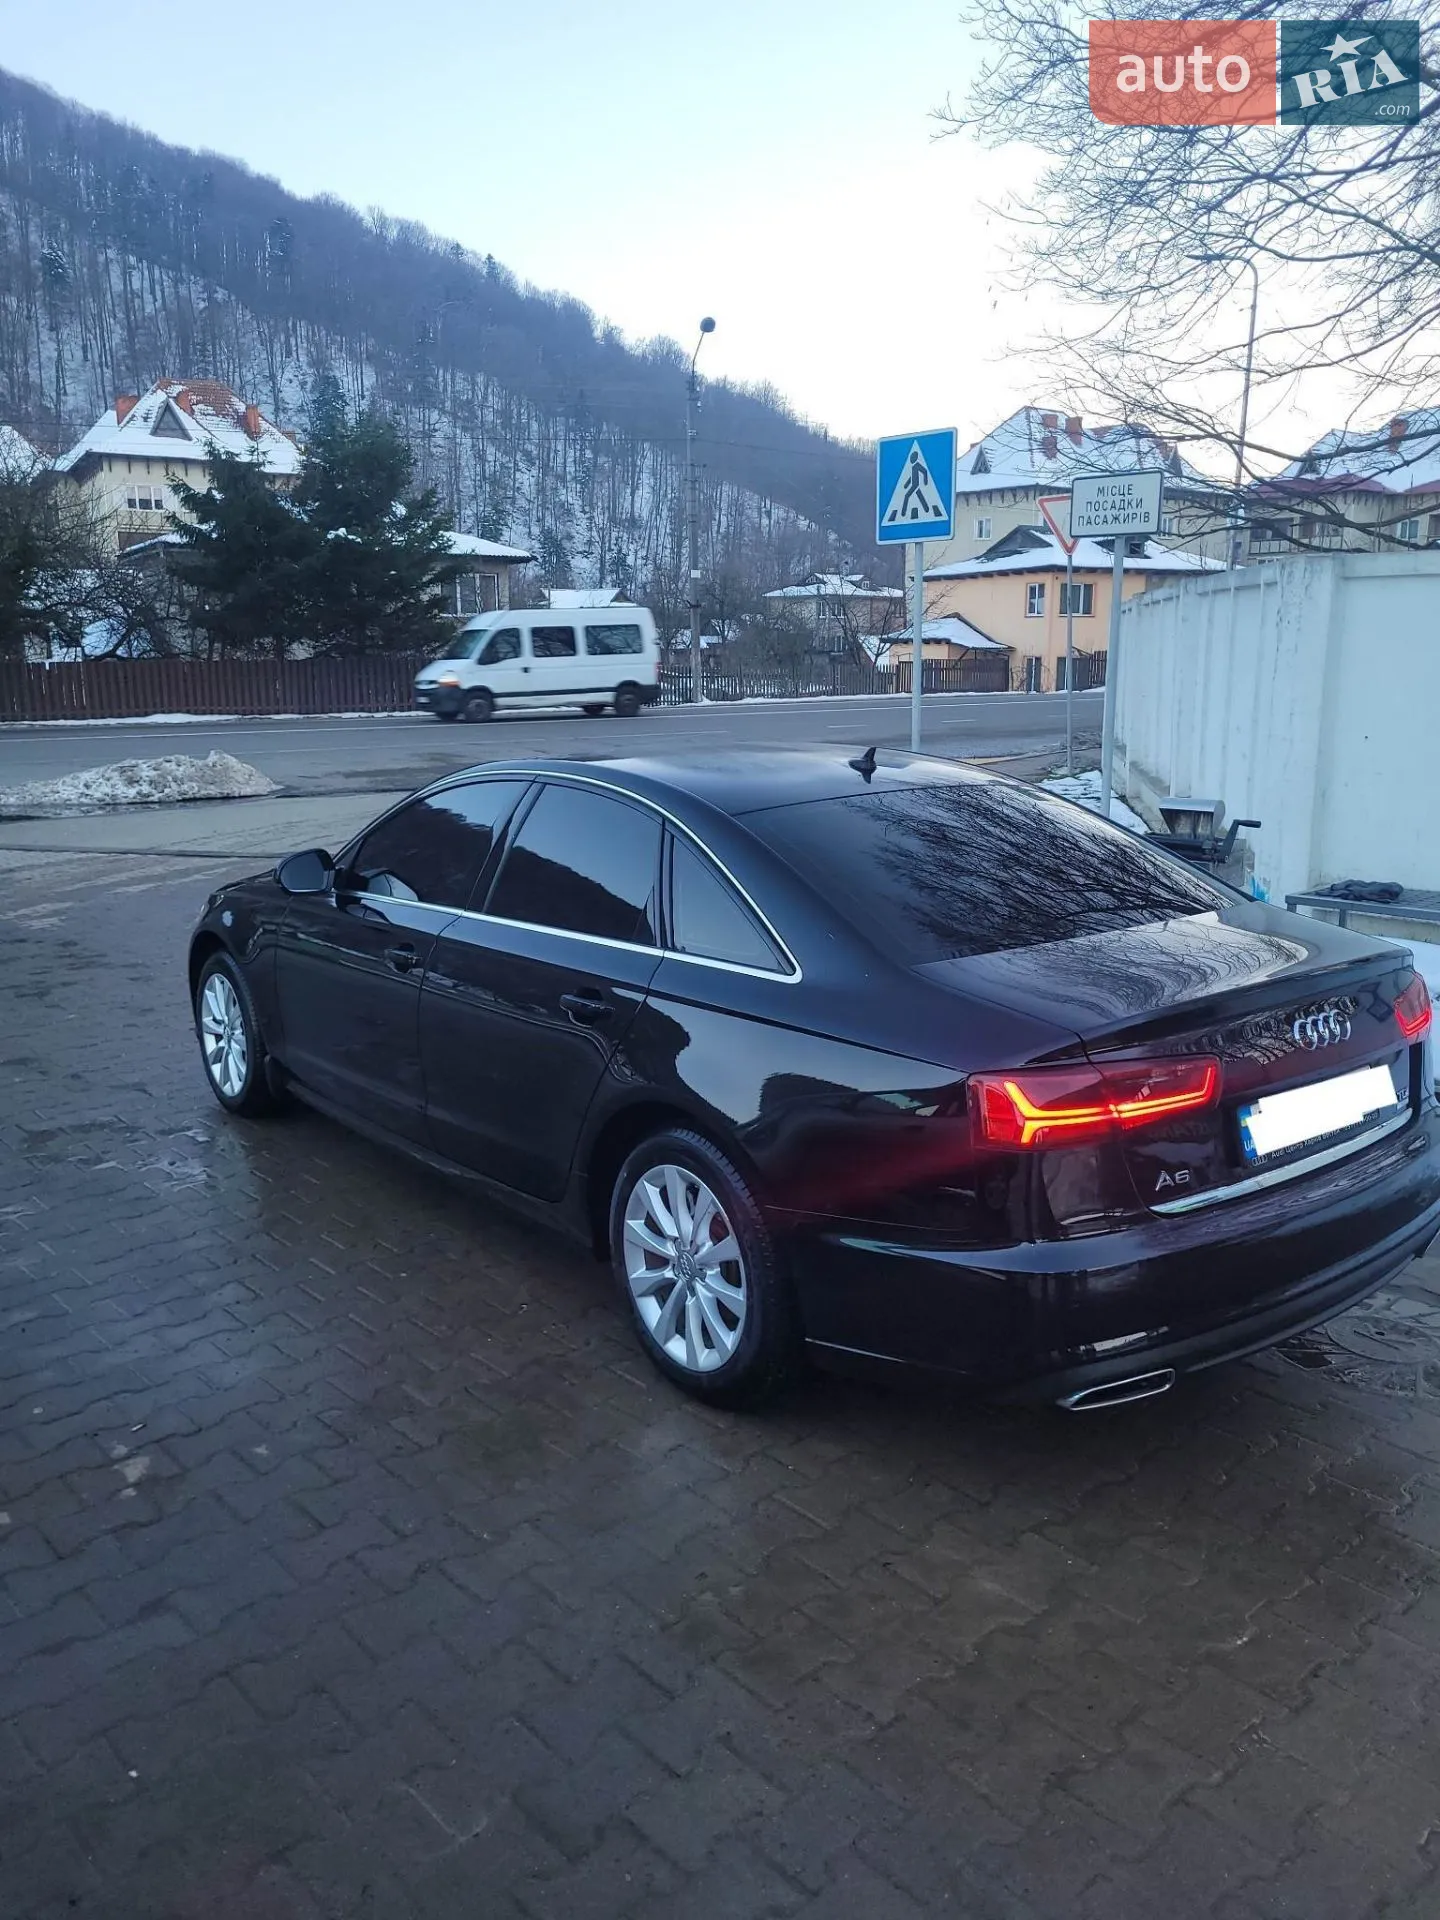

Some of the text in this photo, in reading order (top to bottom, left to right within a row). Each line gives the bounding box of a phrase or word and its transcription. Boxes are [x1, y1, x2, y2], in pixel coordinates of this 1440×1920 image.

[1096, 483, 1134, 498] МІСЦЕ
[1085, 497, 1143, 513] ПОСАДКИ
[1077, 511, 1150, 527] ПАСАЖИРІВ
[1155, 1169, 1190, 1191] A6
